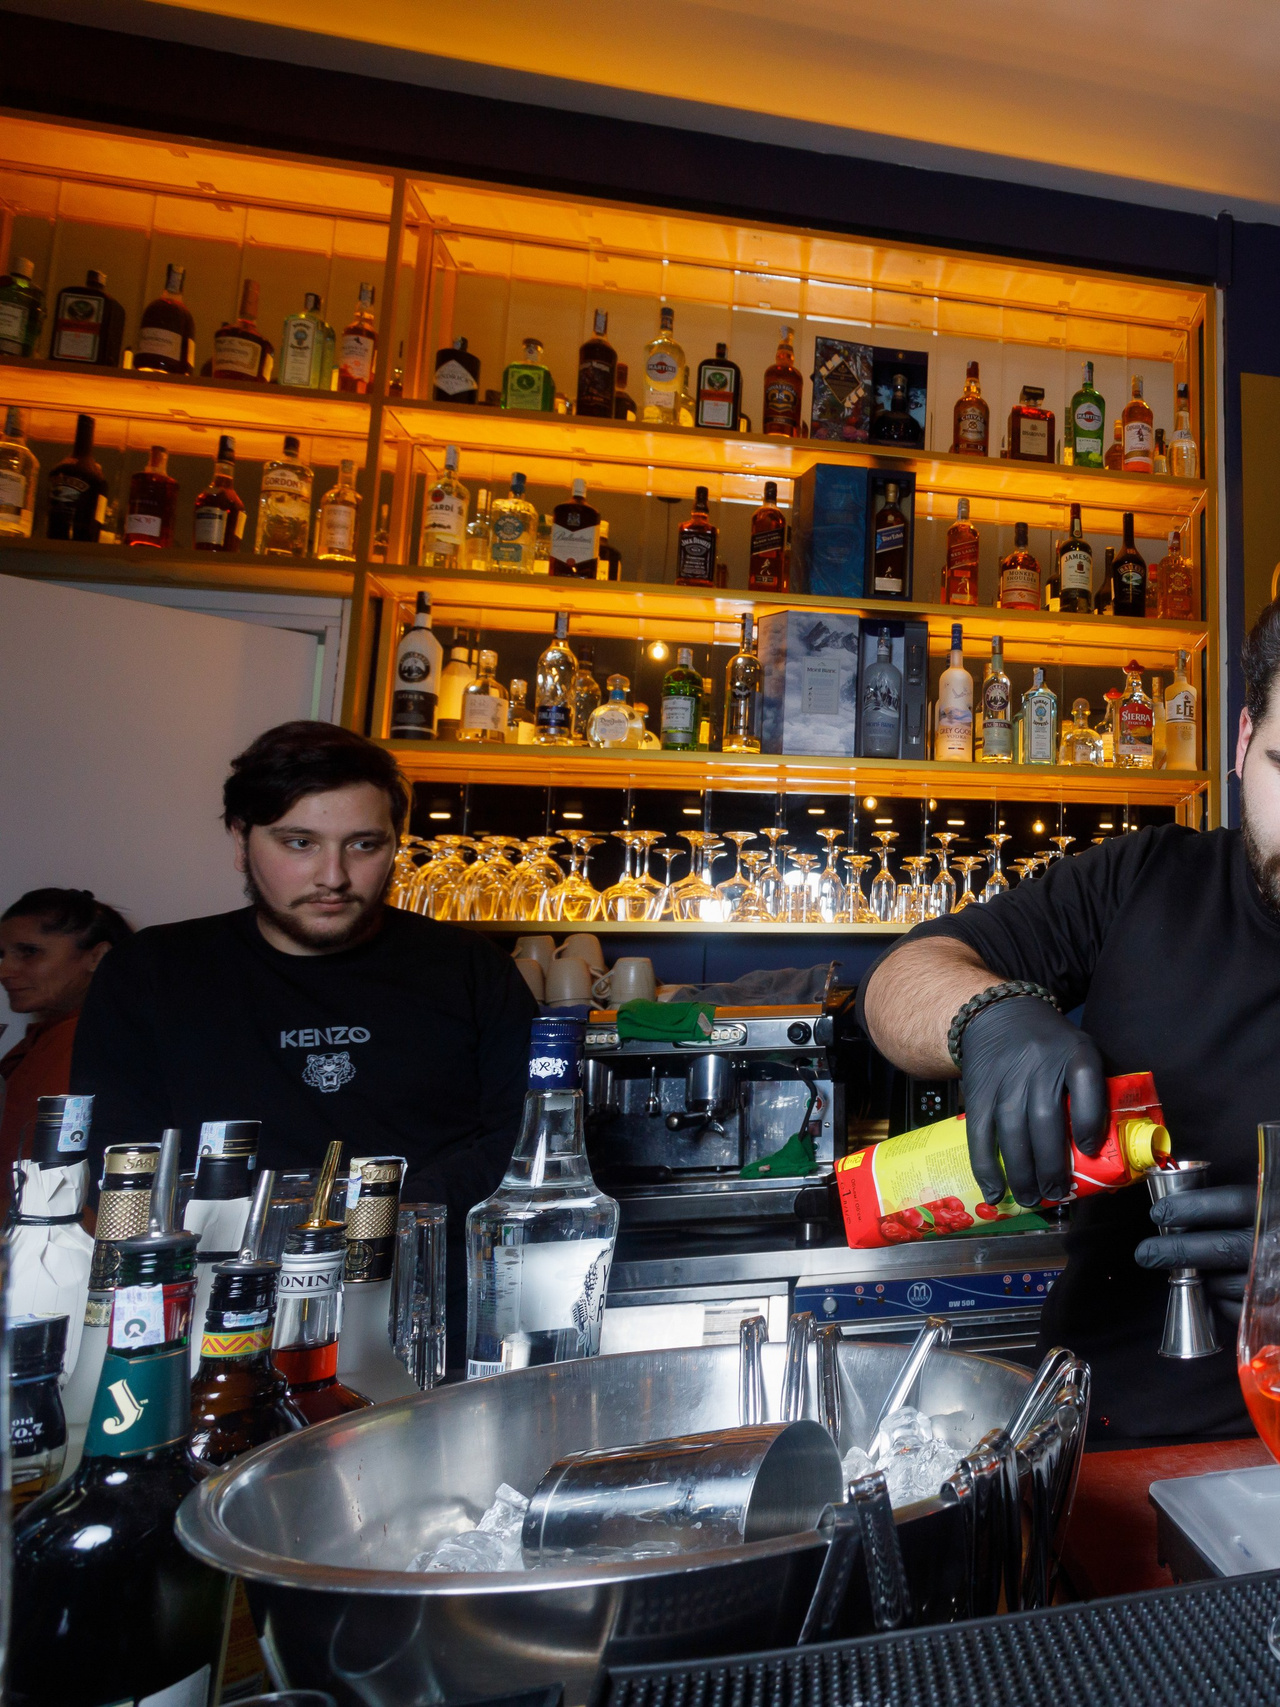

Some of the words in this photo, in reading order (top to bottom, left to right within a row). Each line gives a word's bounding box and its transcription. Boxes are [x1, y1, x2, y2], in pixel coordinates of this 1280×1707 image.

[647, 364, 676, 373] MARTINI
[776, 392, 784, 400] 18
[961, 414, 985, 423] CHIVAS
[1077, 413, 1102, 422] MARTINI
[1121, 710, 1151, 722] SIERRA
[280, 1026, 371, 1049] KENZO
[280, 1273, 331, 1287] ONIN
[961, 1299, 975, 1307] 500
